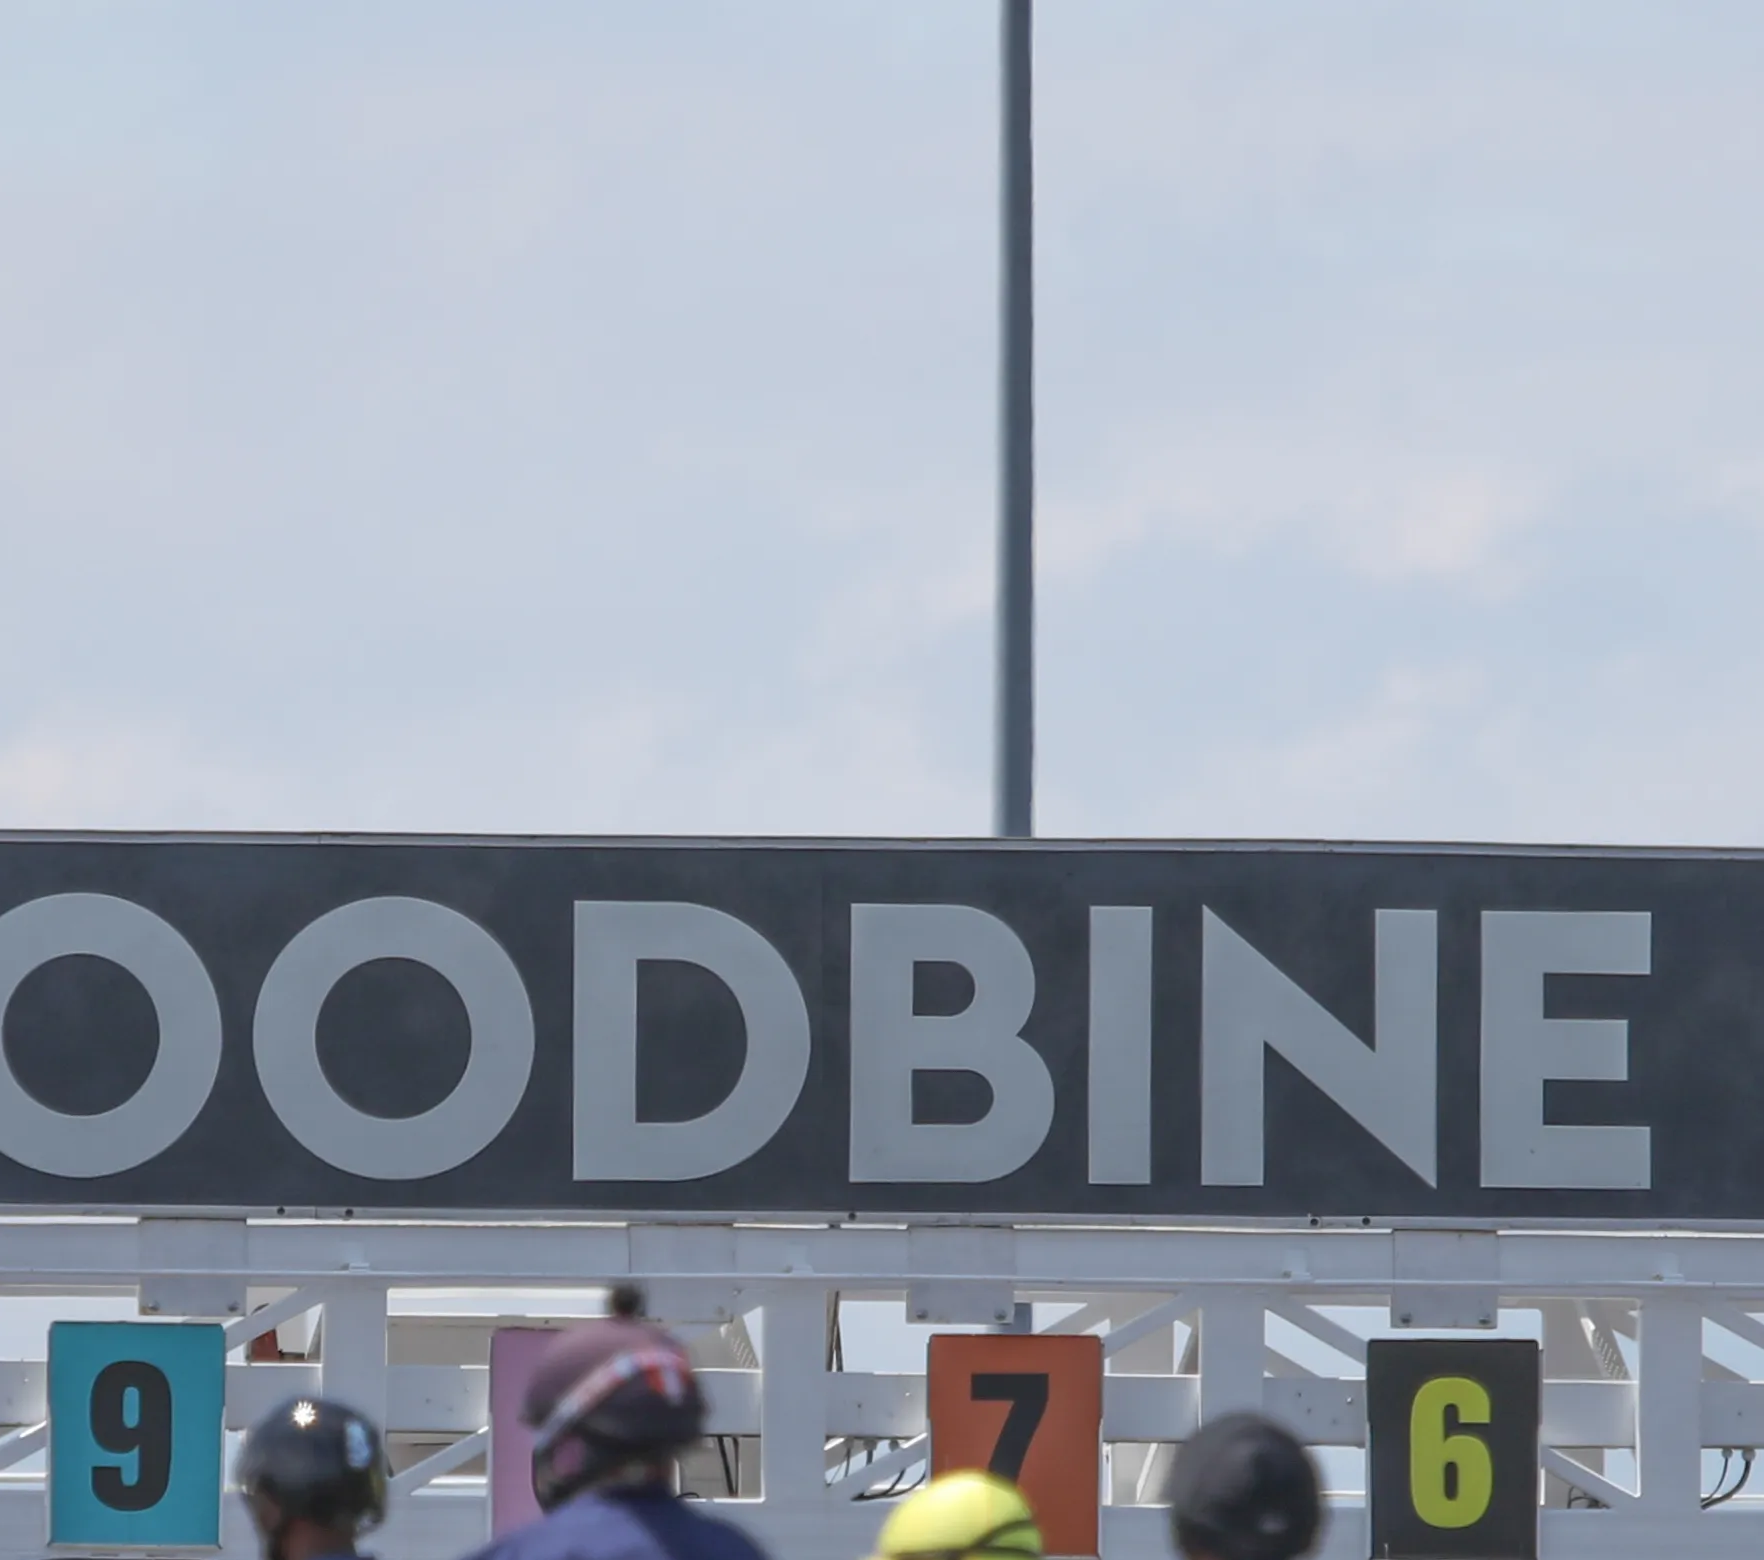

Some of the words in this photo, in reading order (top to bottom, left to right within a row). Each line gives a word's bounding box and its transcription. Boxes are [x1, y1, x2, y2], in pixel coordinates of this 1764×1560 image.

[89, 1359, 173, 1512] 9
[970, 1373, 1050, 1486] 7
[1409, 1376, 1493, 1528] 6
